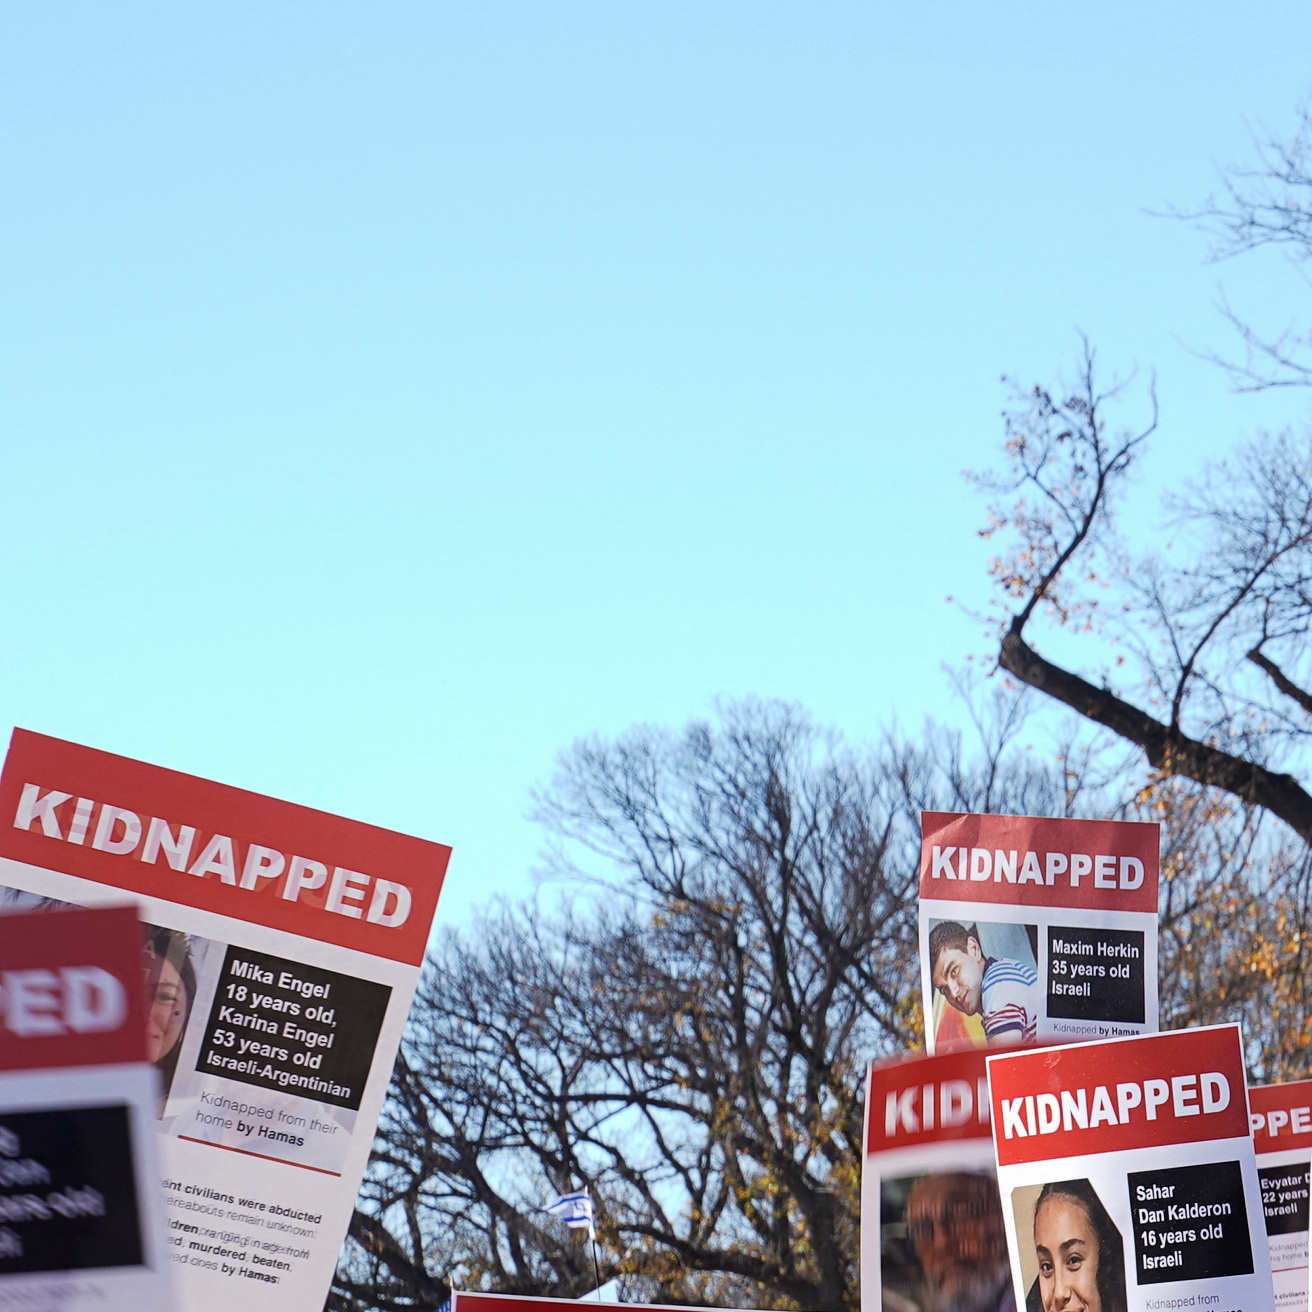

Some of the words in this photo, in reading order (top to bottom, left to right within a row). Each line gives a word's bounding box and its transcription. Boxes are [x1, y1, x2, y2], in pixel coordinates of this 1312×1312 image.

[13, 782, 412, 929] KIDNAPPED
[931, 846, 1145, 890] KIDNAPPED
[1052, 939, 1094, 956] Maxim
[1097, 941, 1139, 959] Herkin
[230, 959, 274, 985] Mika
[277, 971, 331, 999] Engel
[1052, 959, 1068, 975] 35
[1070, 964, 1106, 979] years
[1109, 963, 1130, 979] old
[1052, 980, 1090, 997] Israeli
[226, 983, 248, 1002] 18
[249, 992, 301, 1016] years
[305, 1006, 337, 1028] old,
[218, 1005, 279, 1035] Karina
[282, 1021, 335, 1049] Engel
[1053, 1022, 1097, 1037] Kidnapped
[1099, 1026, 1110, 1037] by
[212, 1028, 236, 1048] 53
[237, 1038, 289, 1061] years
[292, 1051, 323, 1070] old
[206, 1050, 351, 1099] Israeli-Argentinian
[1001, 1072, 1230, 1140] KIDNAPPED
[1136, 1184, 1175, 1202] Sahar
[1260, 1174, 1306, 1190] Evyatar
[1138, 1208, 1165, 1224] Dan
[1167, 1202, 1232, 1221] Kalderon
[1264, 1202, 1298, 1217] Israeli
[1141, 1230, 1157, 1247] 16
[1158, 1229, 1197, 1249] years
[1200, 1223, 1223, 1240] old
[1142, 1250, 1183, 1270] Israeli
